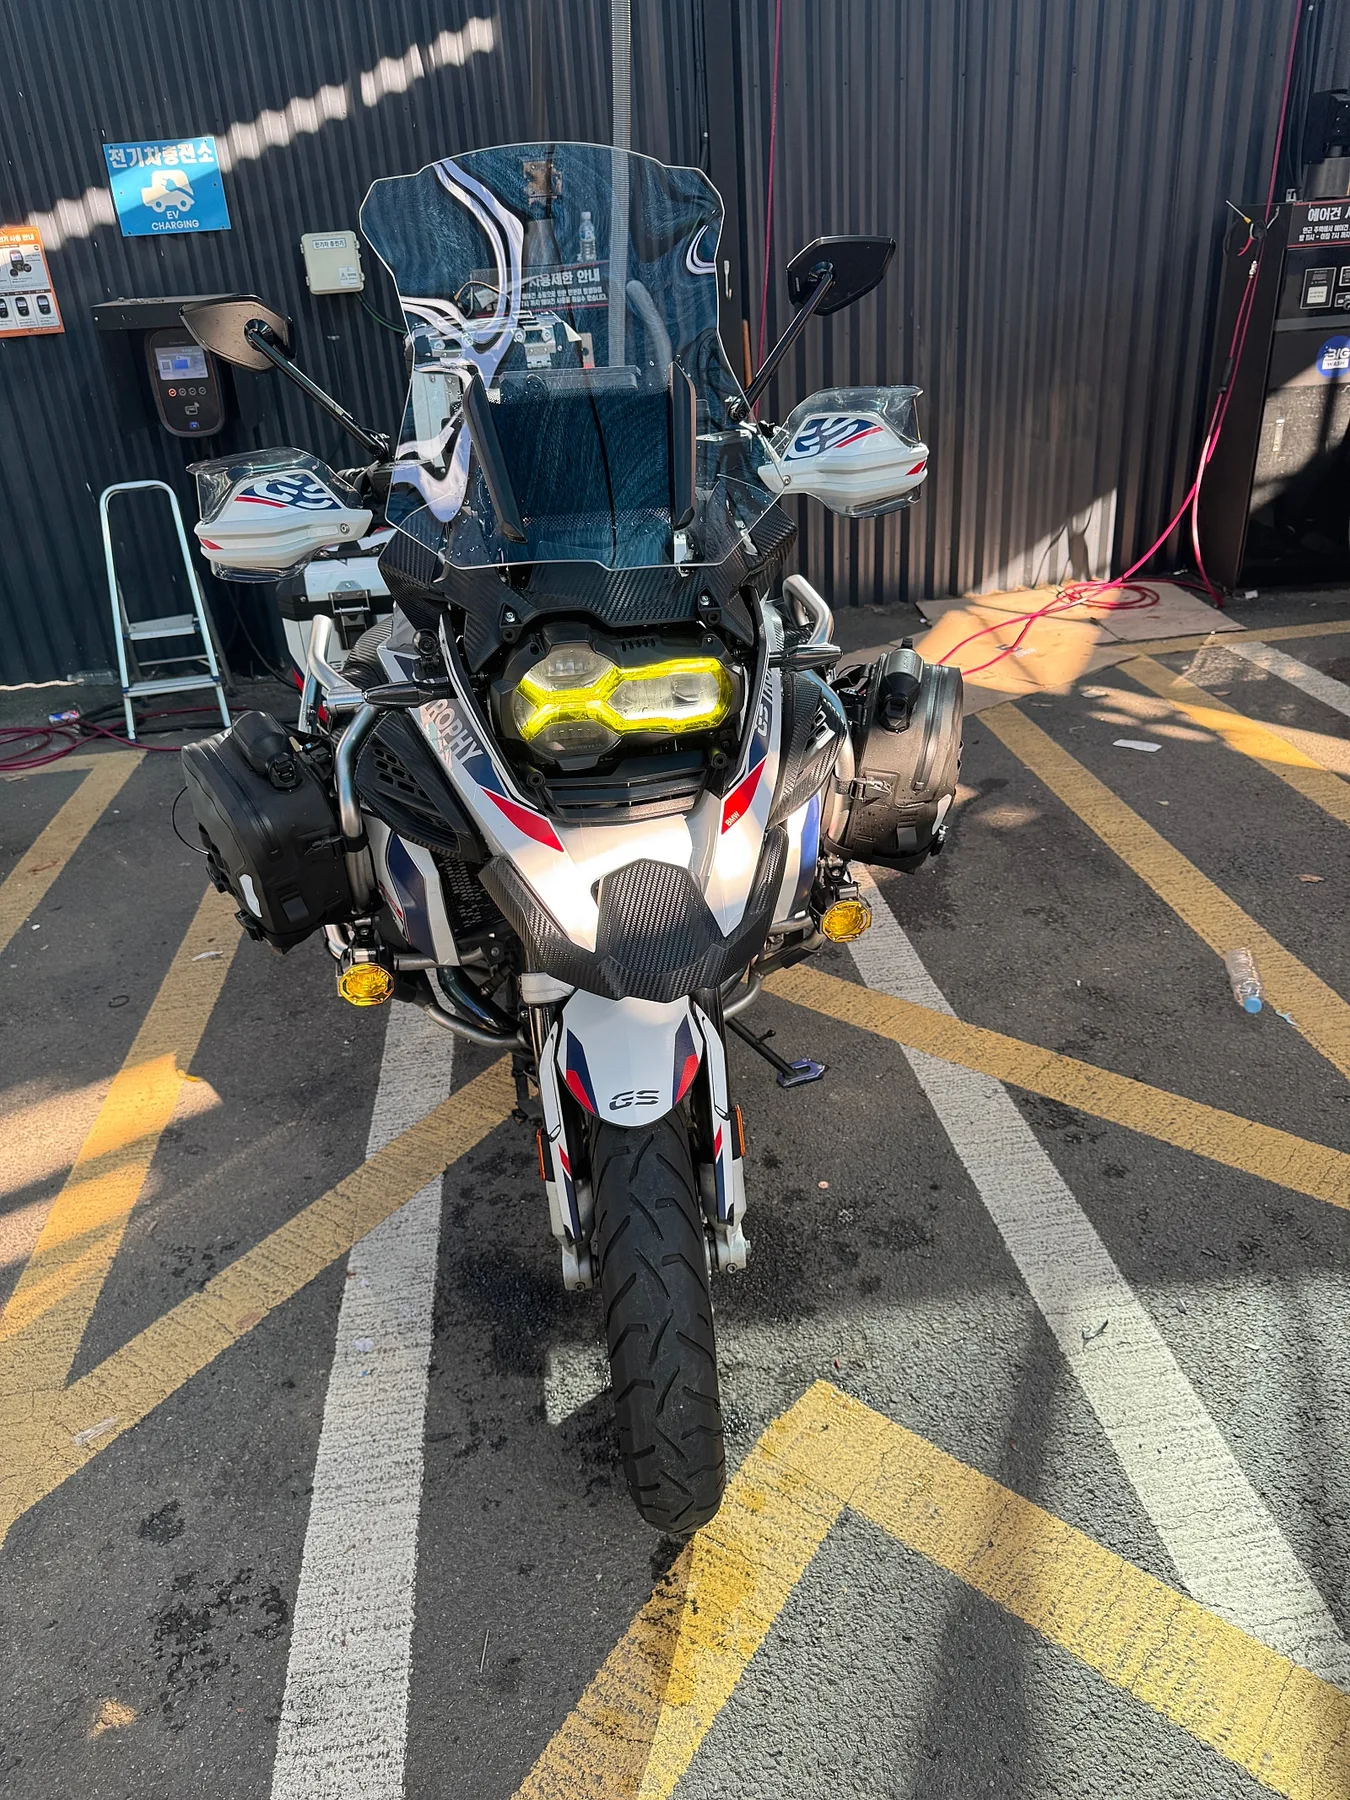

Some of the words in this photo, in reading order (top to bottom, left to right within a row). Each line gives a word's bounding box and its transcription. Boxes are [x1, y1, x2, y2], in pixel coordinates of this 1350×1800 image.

[108, 143, 214, 168] 전기차충전소
[166, 210, 179, 220] EV
[1307, 207, 1341, 222] 에어건
[151, 219, 199, 231] CHARGING
[577, 268, 600, 283] 안내
[1324, 348, 1350, 359] BIG
[422, 699, 484, 765] ROPHY
[725, 810, 740, 827] BMW
[608, 1089, 660, 1111] GS
